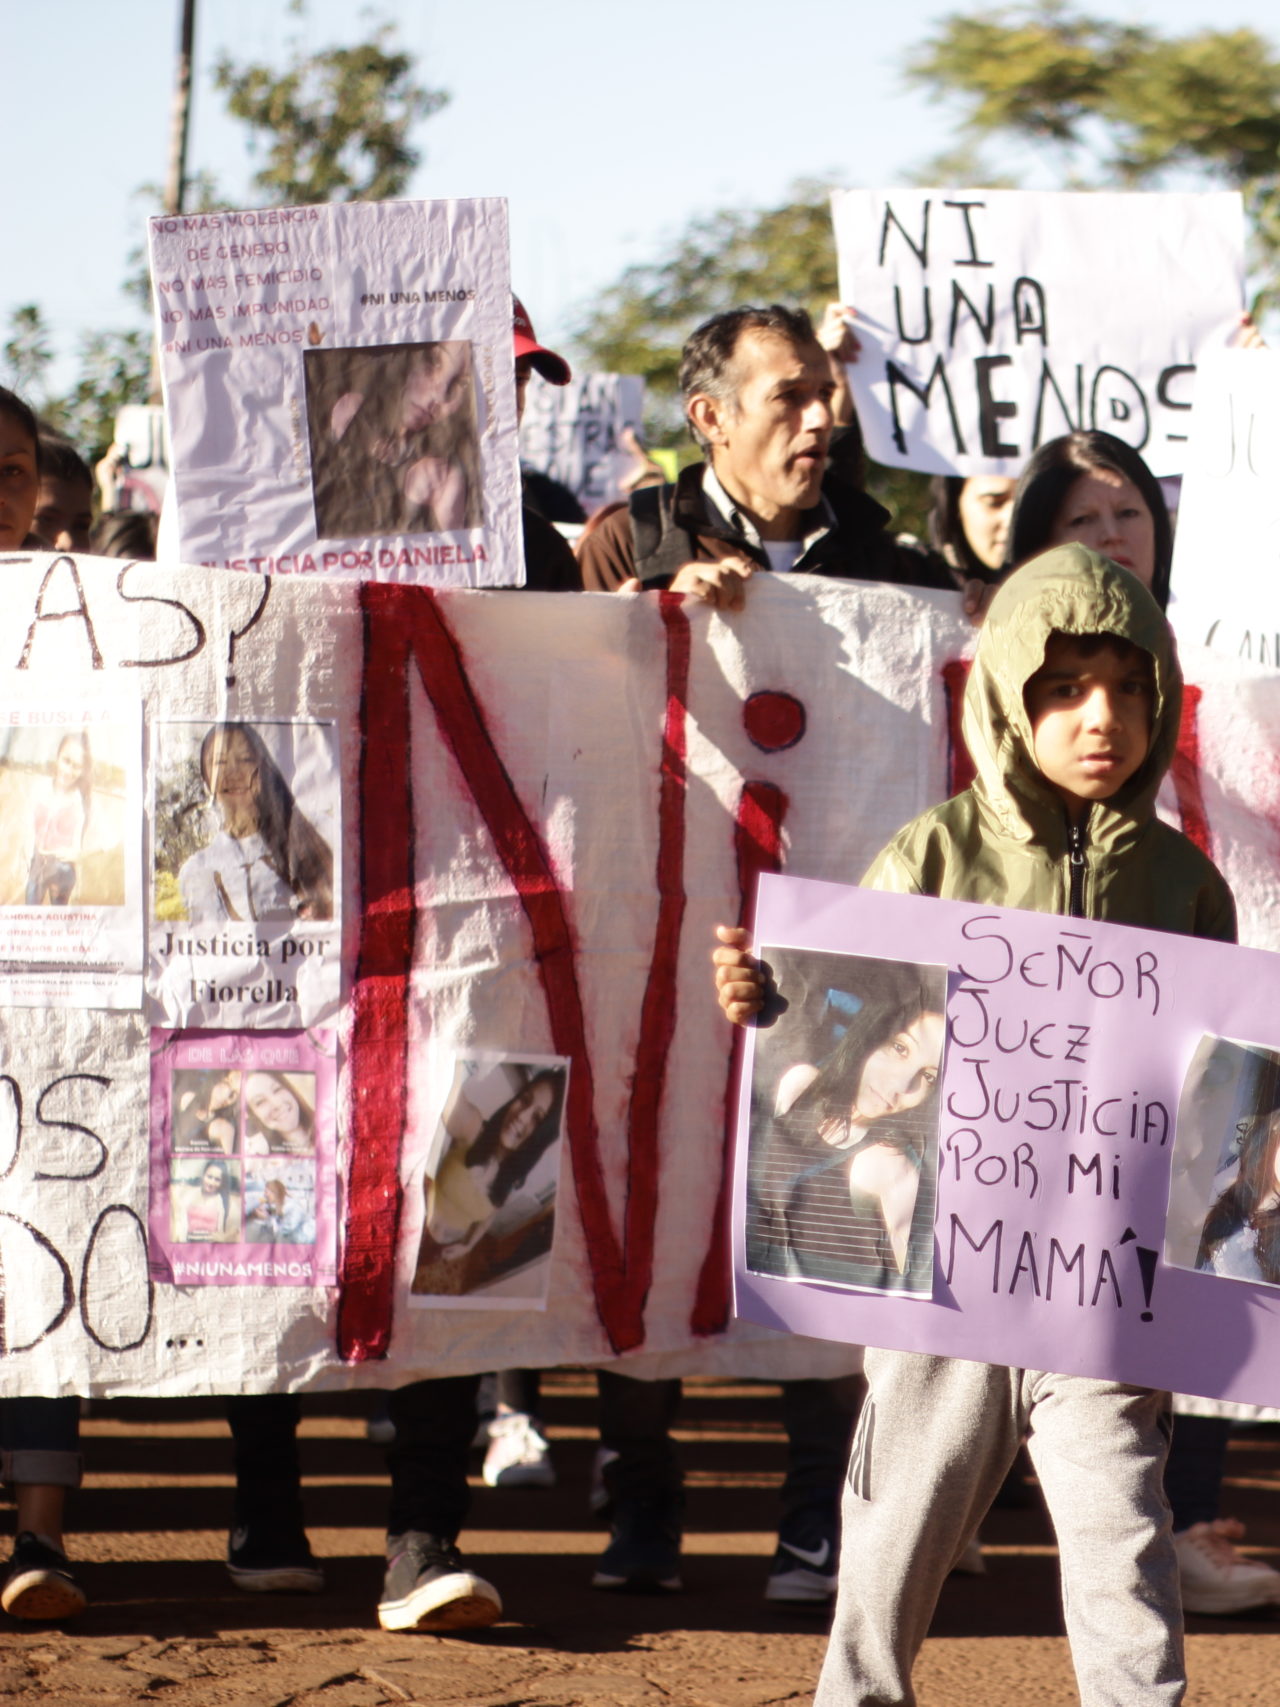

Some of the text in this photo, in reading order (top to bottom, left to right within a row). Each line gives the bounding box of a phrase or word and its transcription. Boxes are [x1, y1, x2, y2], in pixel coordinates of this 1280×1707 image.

[153, 220, 177, 233] NO
[226, 209, 319, 227] VIOLENCIA
[879, 200, 995, 270] NI
[187, 241, 290, 262] DE GENERO
[159, 280, 184, 293] NO
[235, 268, 323, 287] FEMICIDIO
[232, 297, 330, 318] IMPUNIDAD
[360, 289, 476, 306] #NI UNA MENOS
[895, 276, 1047, 348] UNA
[166, 330, 303, 353] #NI UNA MENOS
[323, 551, 373, 572] POR
[379, 544, 489, 569] DANIELA
[159, 932, 331, 964] Justicia por
[957, 915, 1160, 1016] SEÑOR
[190, 979, 299, 1003] Fiorella
[950, 987, 1092, 1064] JUEZ
[947, 1127, 1039, 1199] POR
[172, 1261, 314, 1280] #NIUNAMENOS
[947, 1213, 1159, 1322] MAMÁ!
